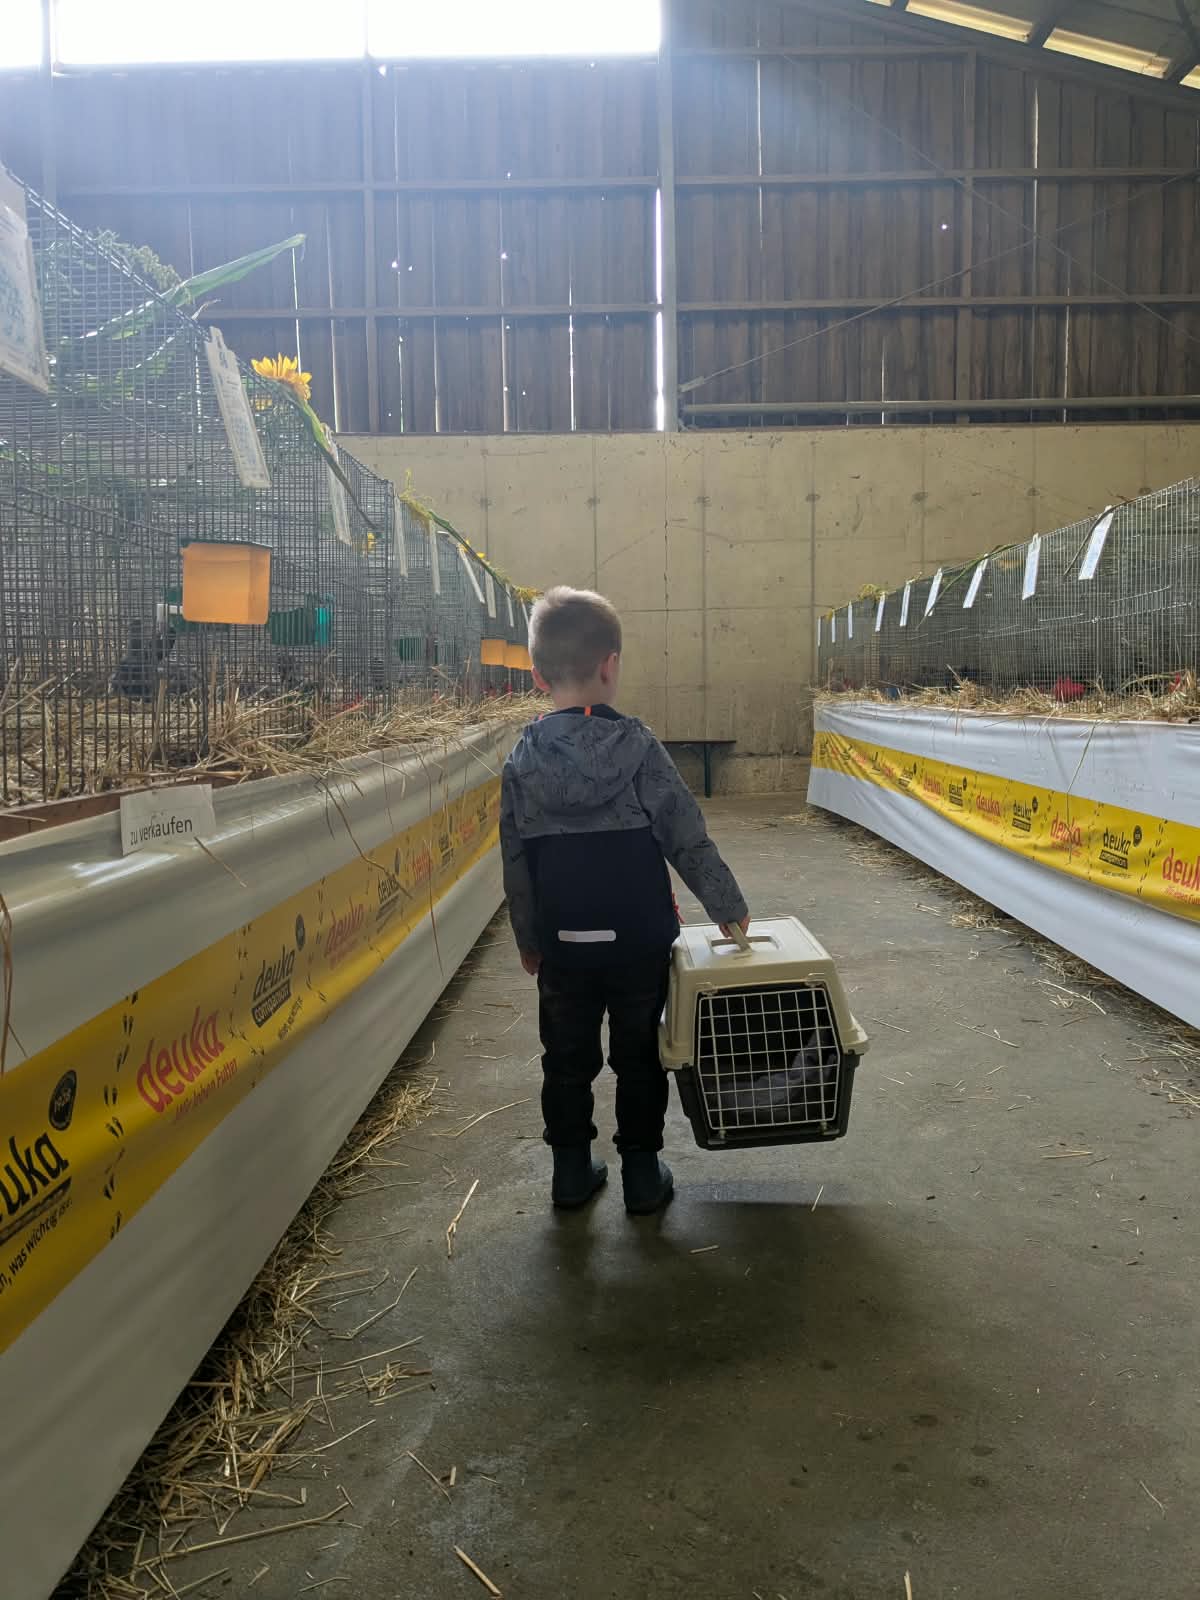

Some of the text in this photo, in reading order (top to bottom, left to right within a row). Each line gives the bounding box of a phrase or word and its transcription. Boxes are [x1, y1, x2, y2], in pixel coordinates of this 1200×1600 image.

[130, 816, 193, 846] zu verkaufen
[1103, 827, 1131, 855] deuka
[254, 944, 295, 1001] deuka
[137, 1006, 226, 1113] deuka
[9, 1247, 28, 1276] was
